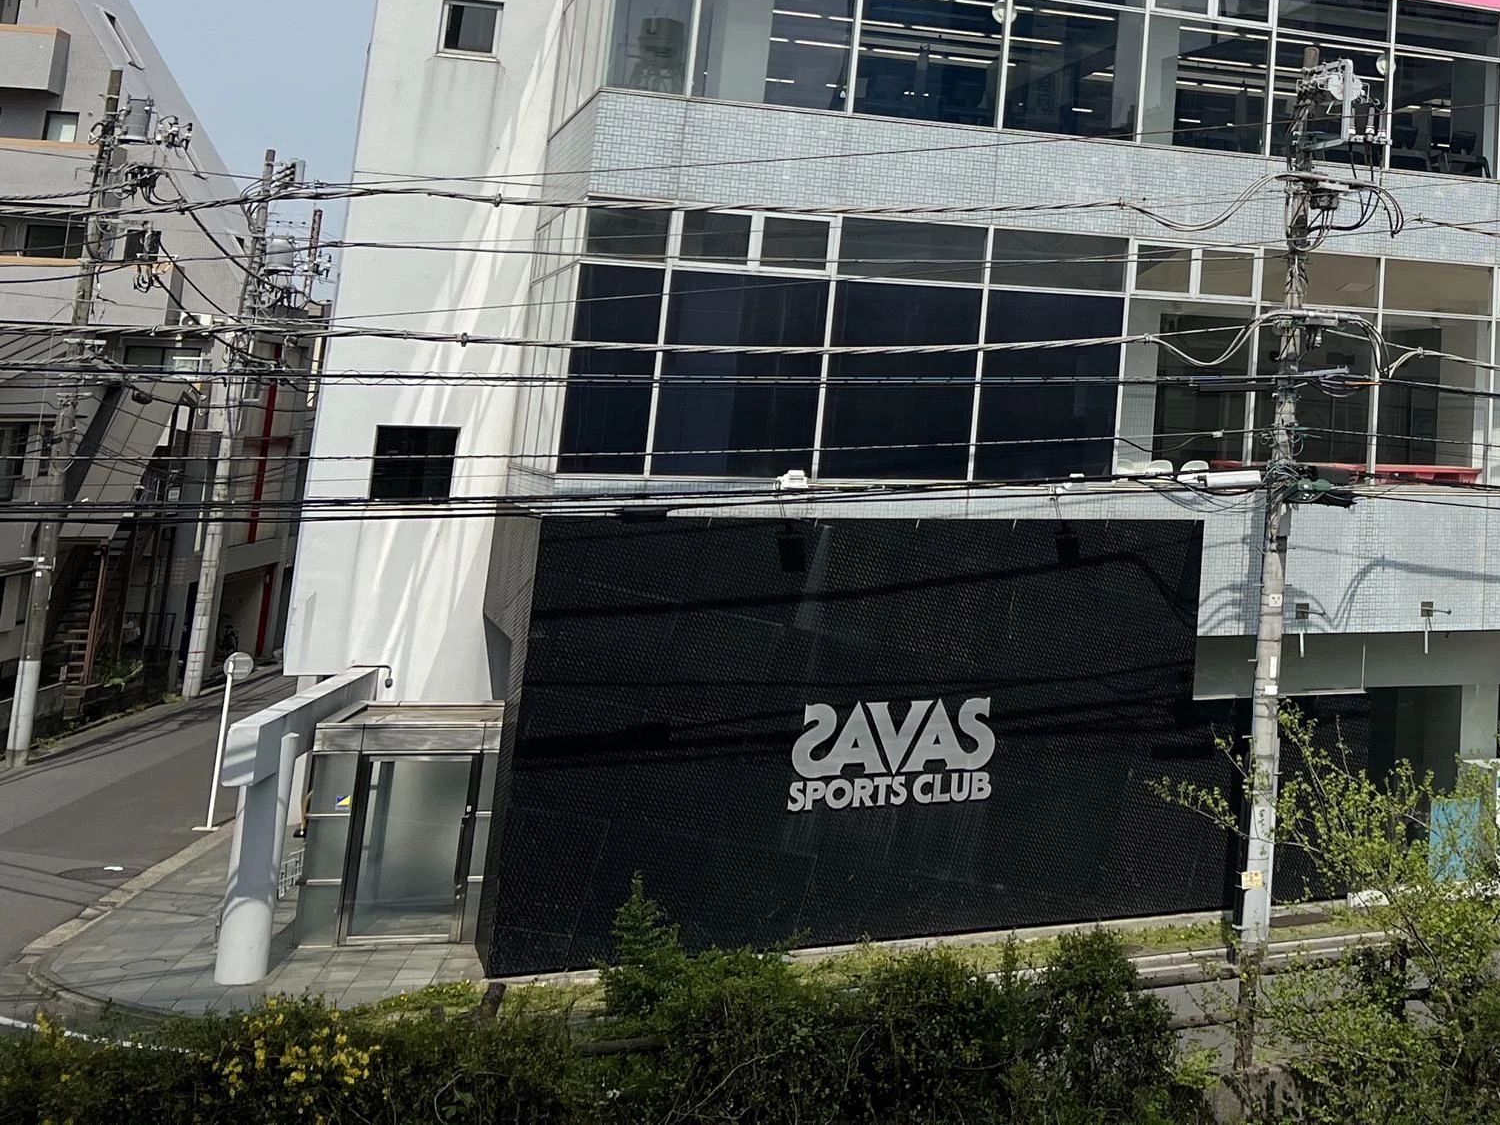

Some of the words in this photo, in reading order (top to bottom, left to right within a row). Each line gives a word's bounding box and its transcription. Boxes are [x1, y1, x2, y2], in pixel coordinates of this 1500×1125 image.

[792, 696, 996, 779] SAVAS
[787, 775, 908, 812] SPORTS
[912, 772, 992, 804] CLUB
